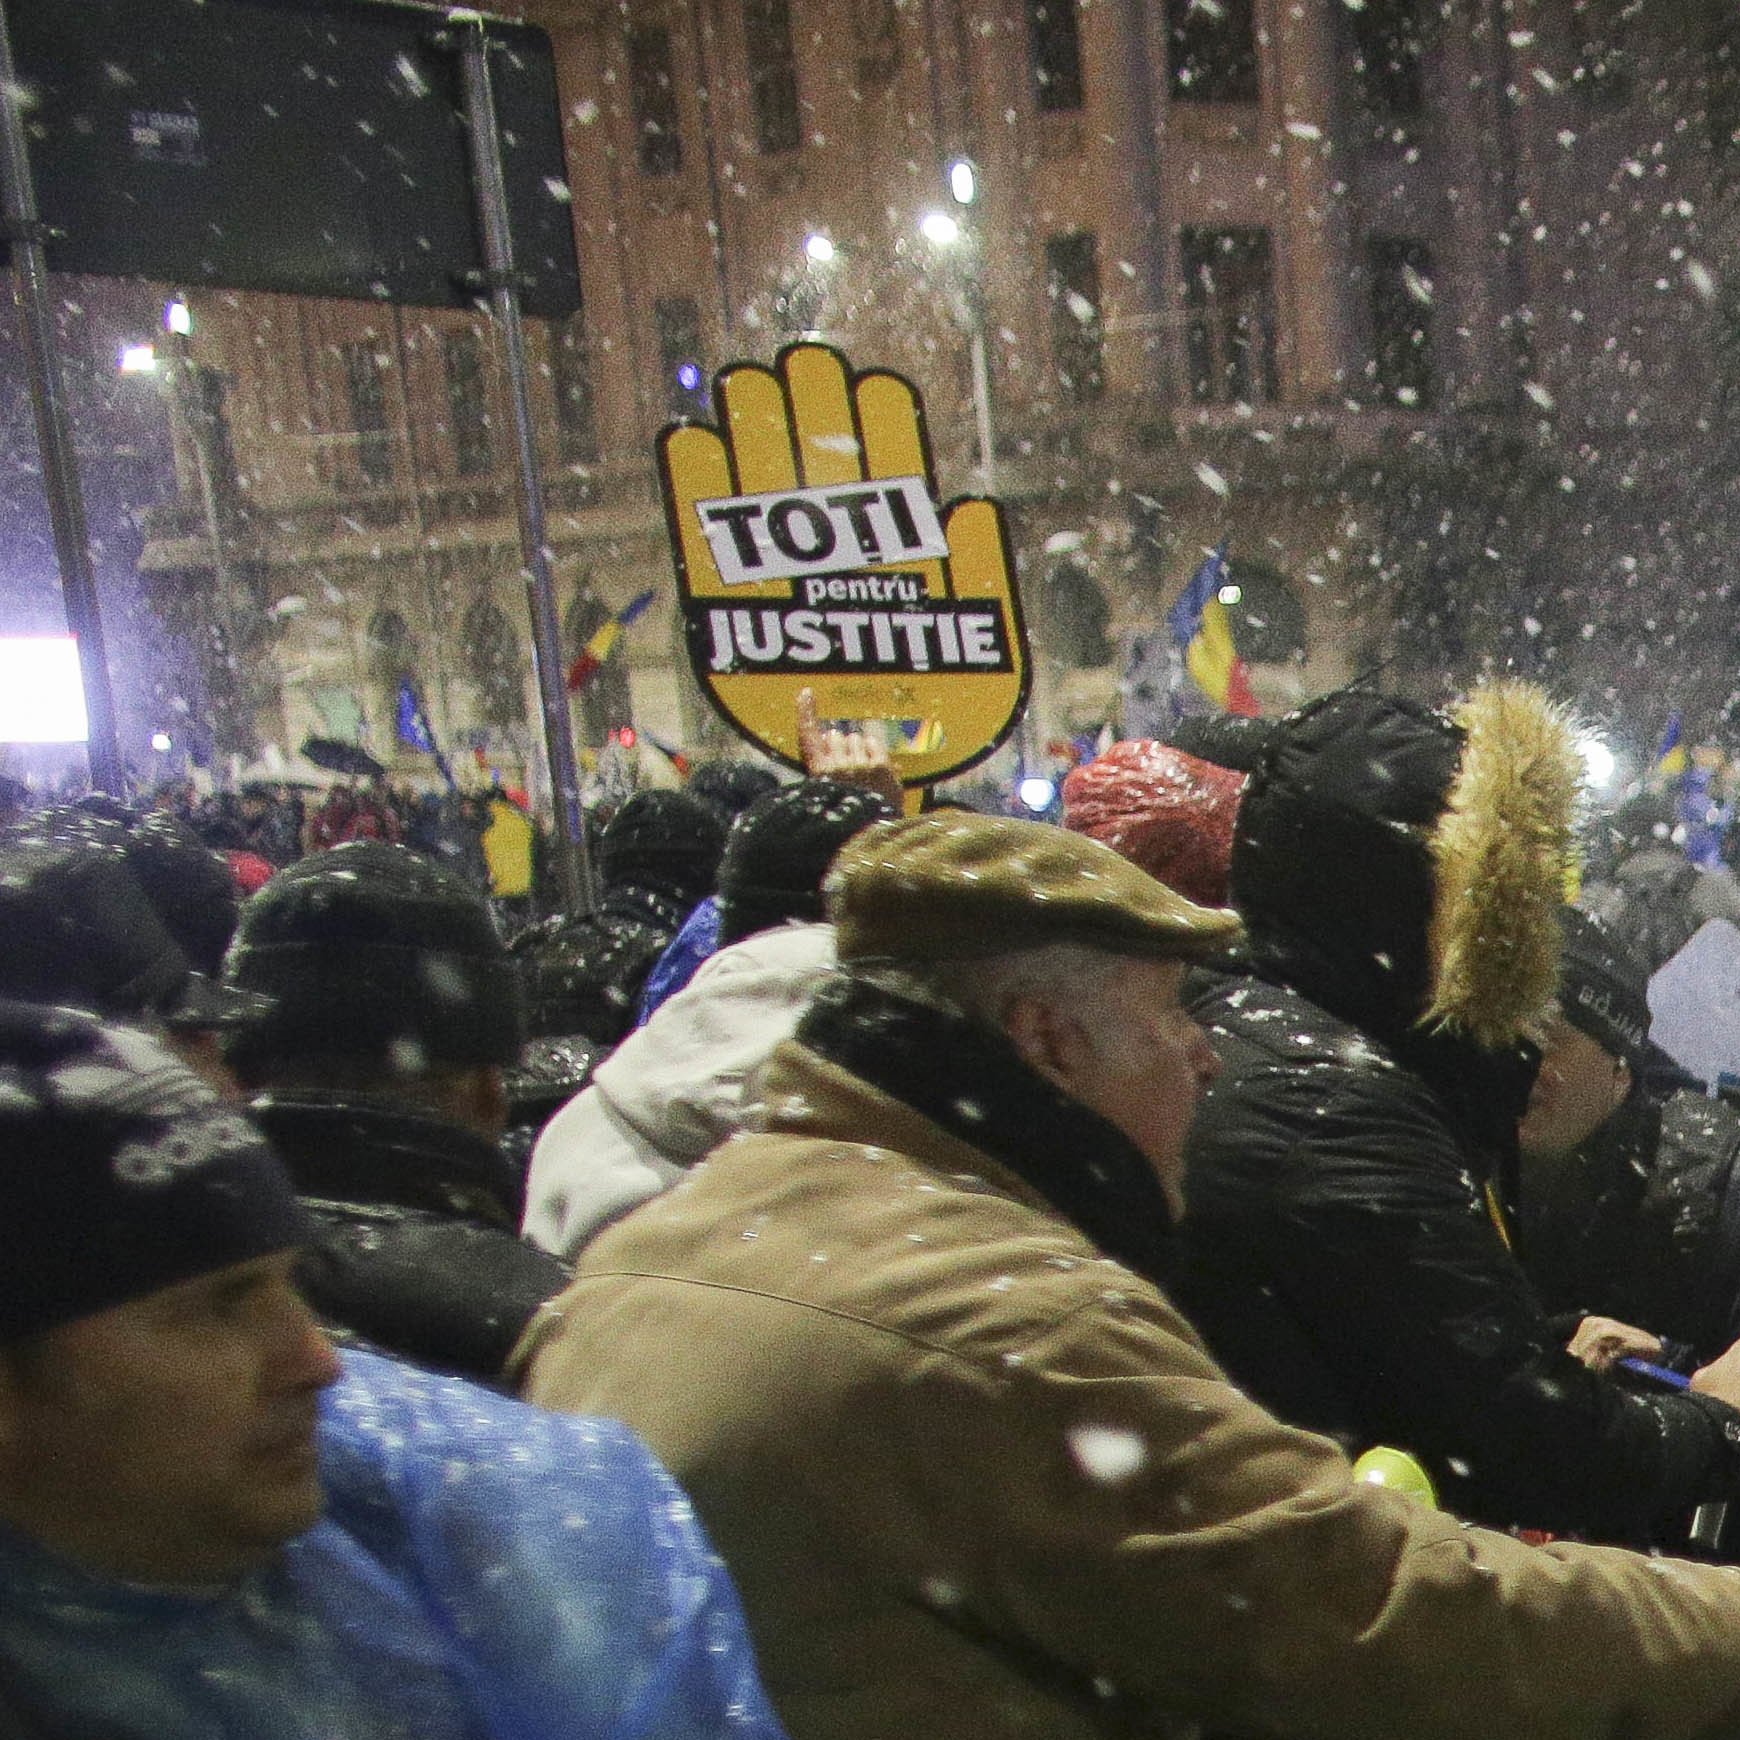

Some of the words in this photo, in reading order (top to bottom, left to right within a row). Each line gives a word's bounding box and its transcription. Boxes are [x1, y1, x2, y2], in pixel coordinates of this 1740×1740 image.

[706, 488, 923, 567] TOȚI
[805, 577, 918, 606] pentru
[709, 608, 1001, 673] JUSTIȚIE
